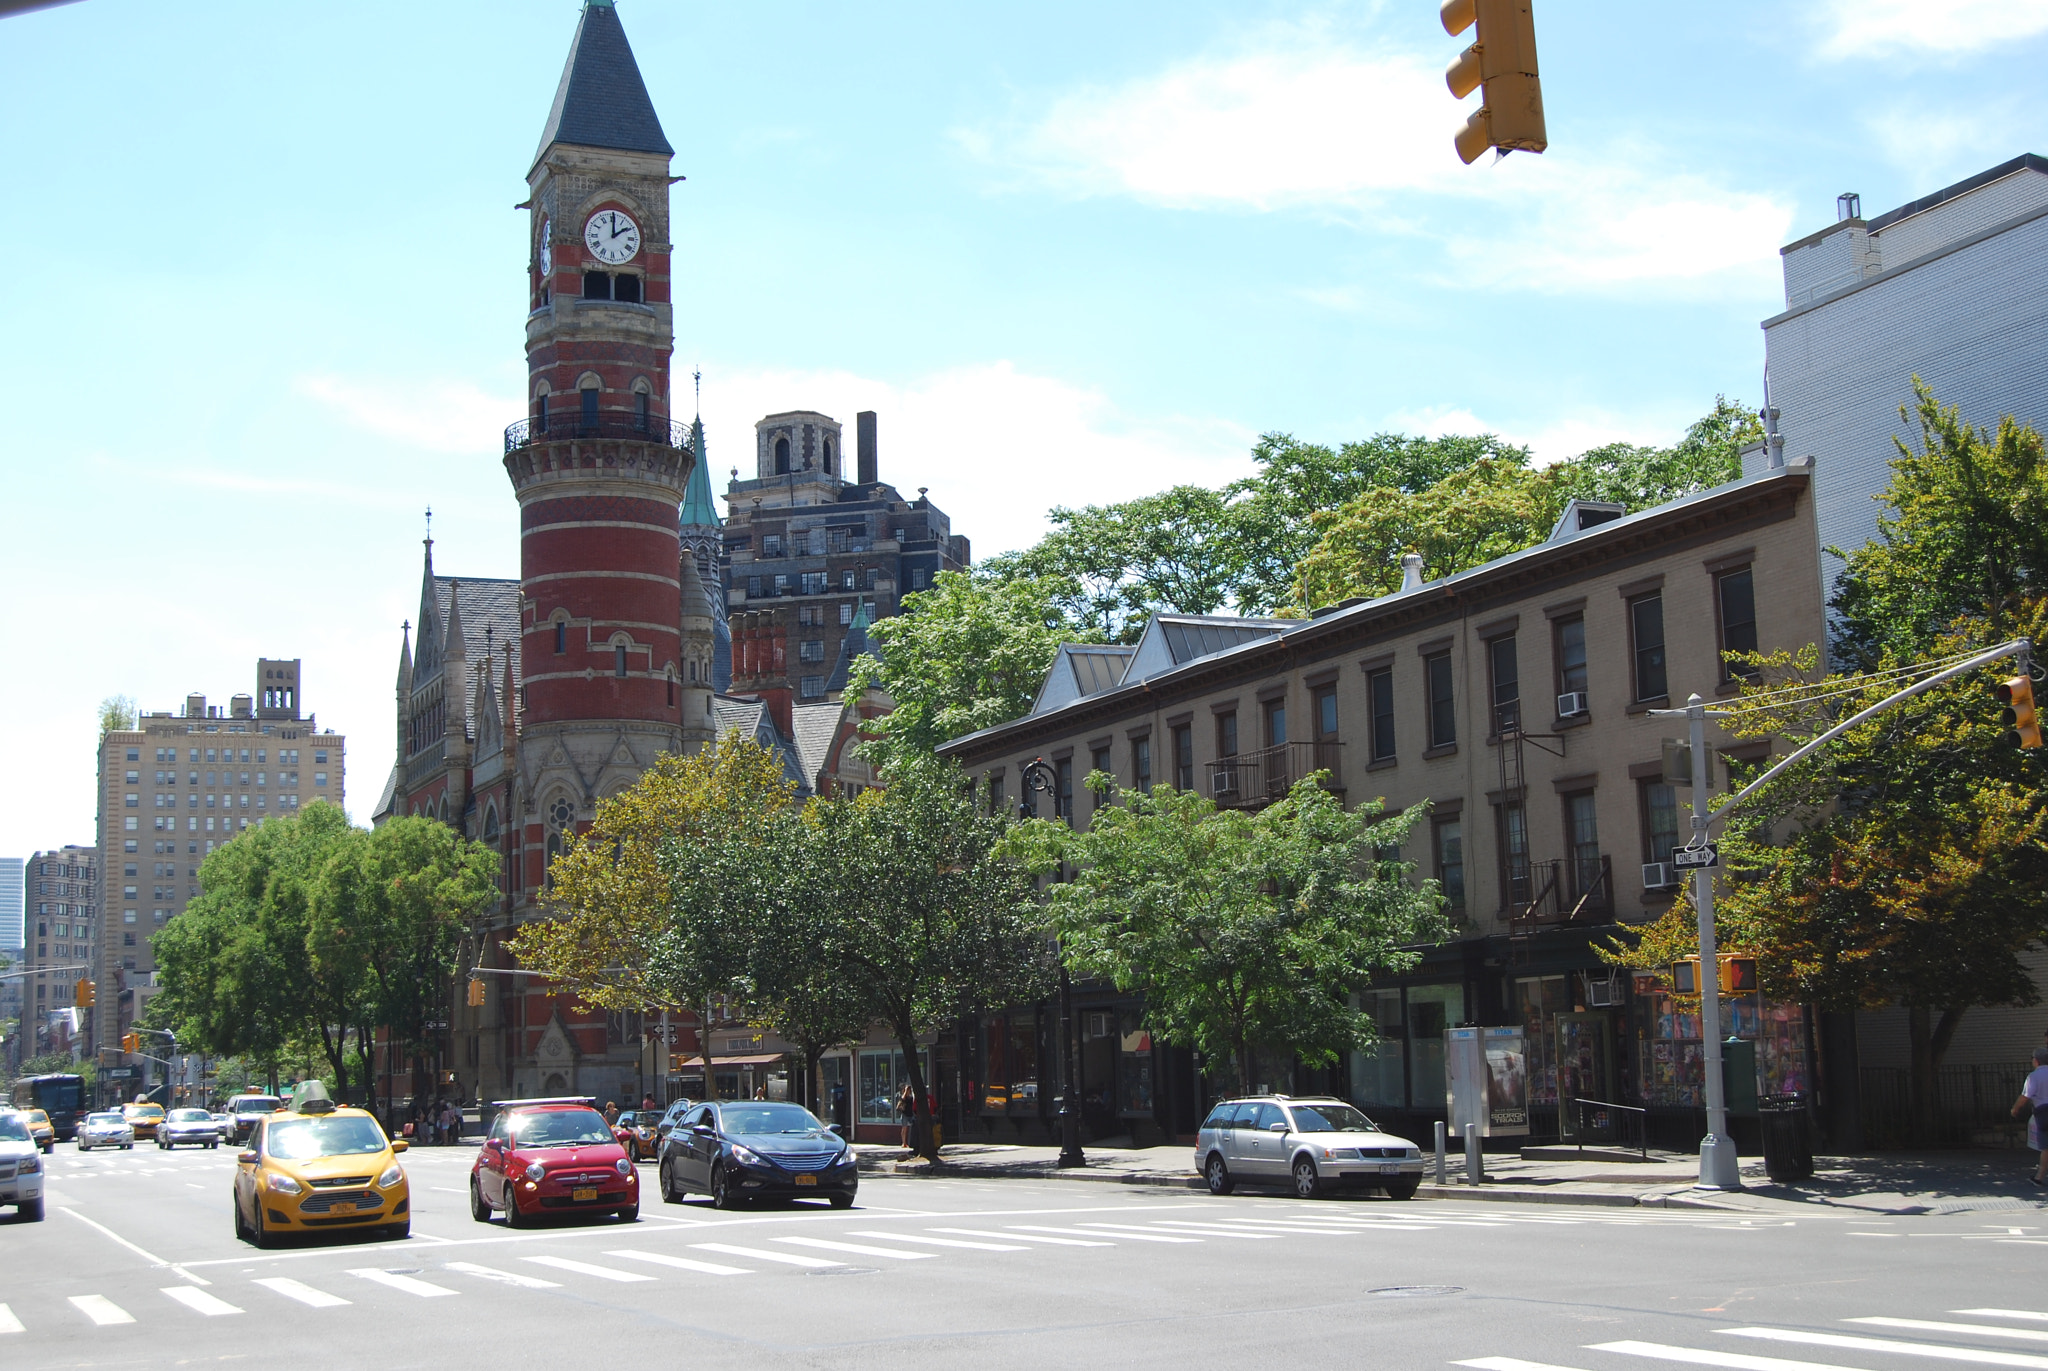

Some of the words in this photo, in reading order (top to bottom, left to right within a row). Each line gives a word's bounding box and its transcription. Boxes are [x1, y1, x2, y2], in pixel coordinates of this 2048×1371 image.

[1679, 853, 1692, 863] ONE
[1697, 851, 1711, 861] WAY
[193, 1063, 213, 1074] Sprnt
